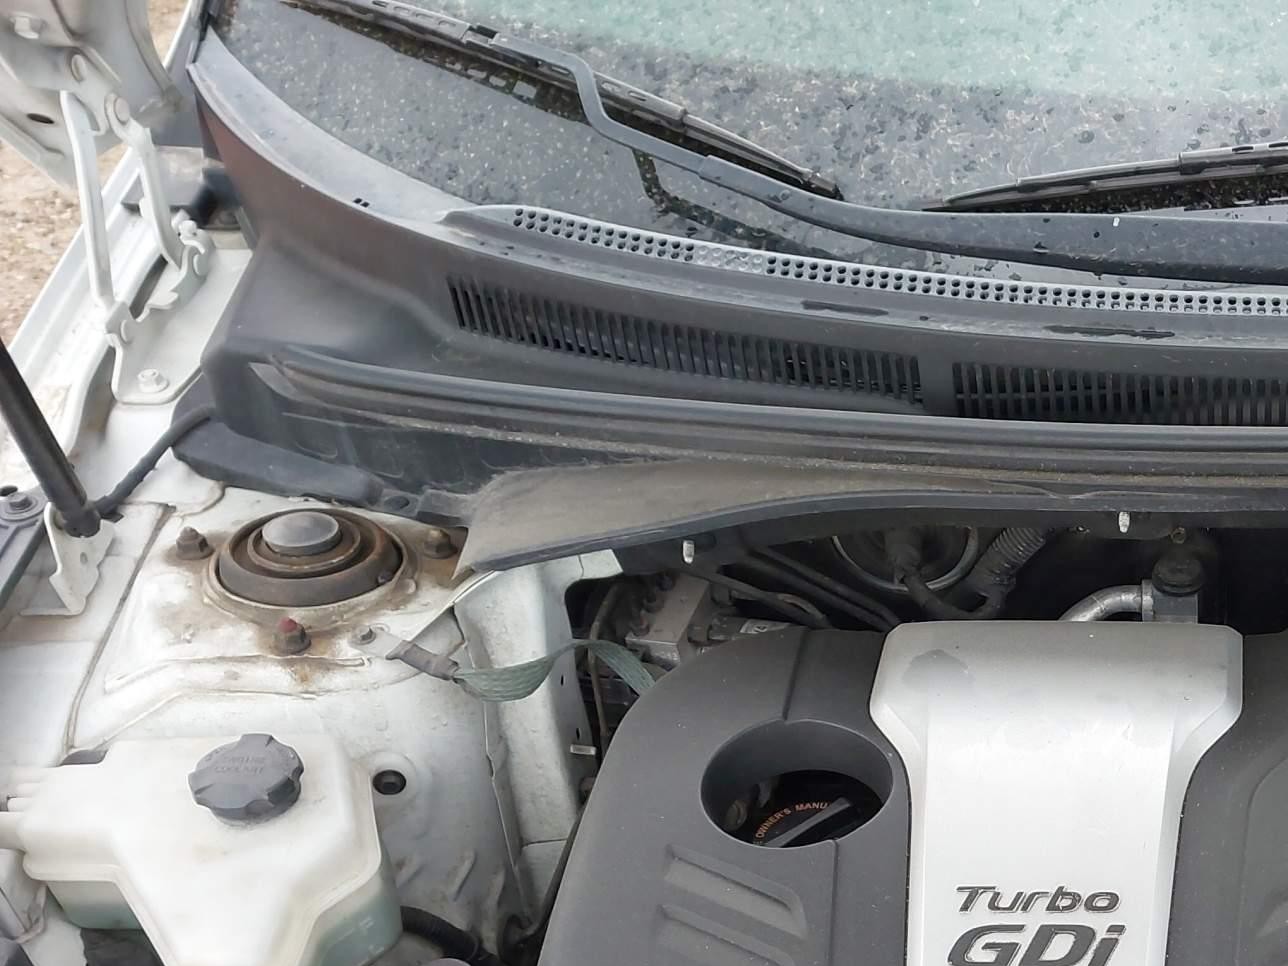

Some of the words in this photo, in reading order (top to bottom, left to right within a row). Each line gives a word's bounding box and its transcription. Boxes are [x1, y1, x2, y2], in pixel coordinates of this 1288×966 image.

[755, 806, 793, 840] OWNER'S
[794, 799, 834, 813] MANU
[955, 885, 1121, 914] Turbo
